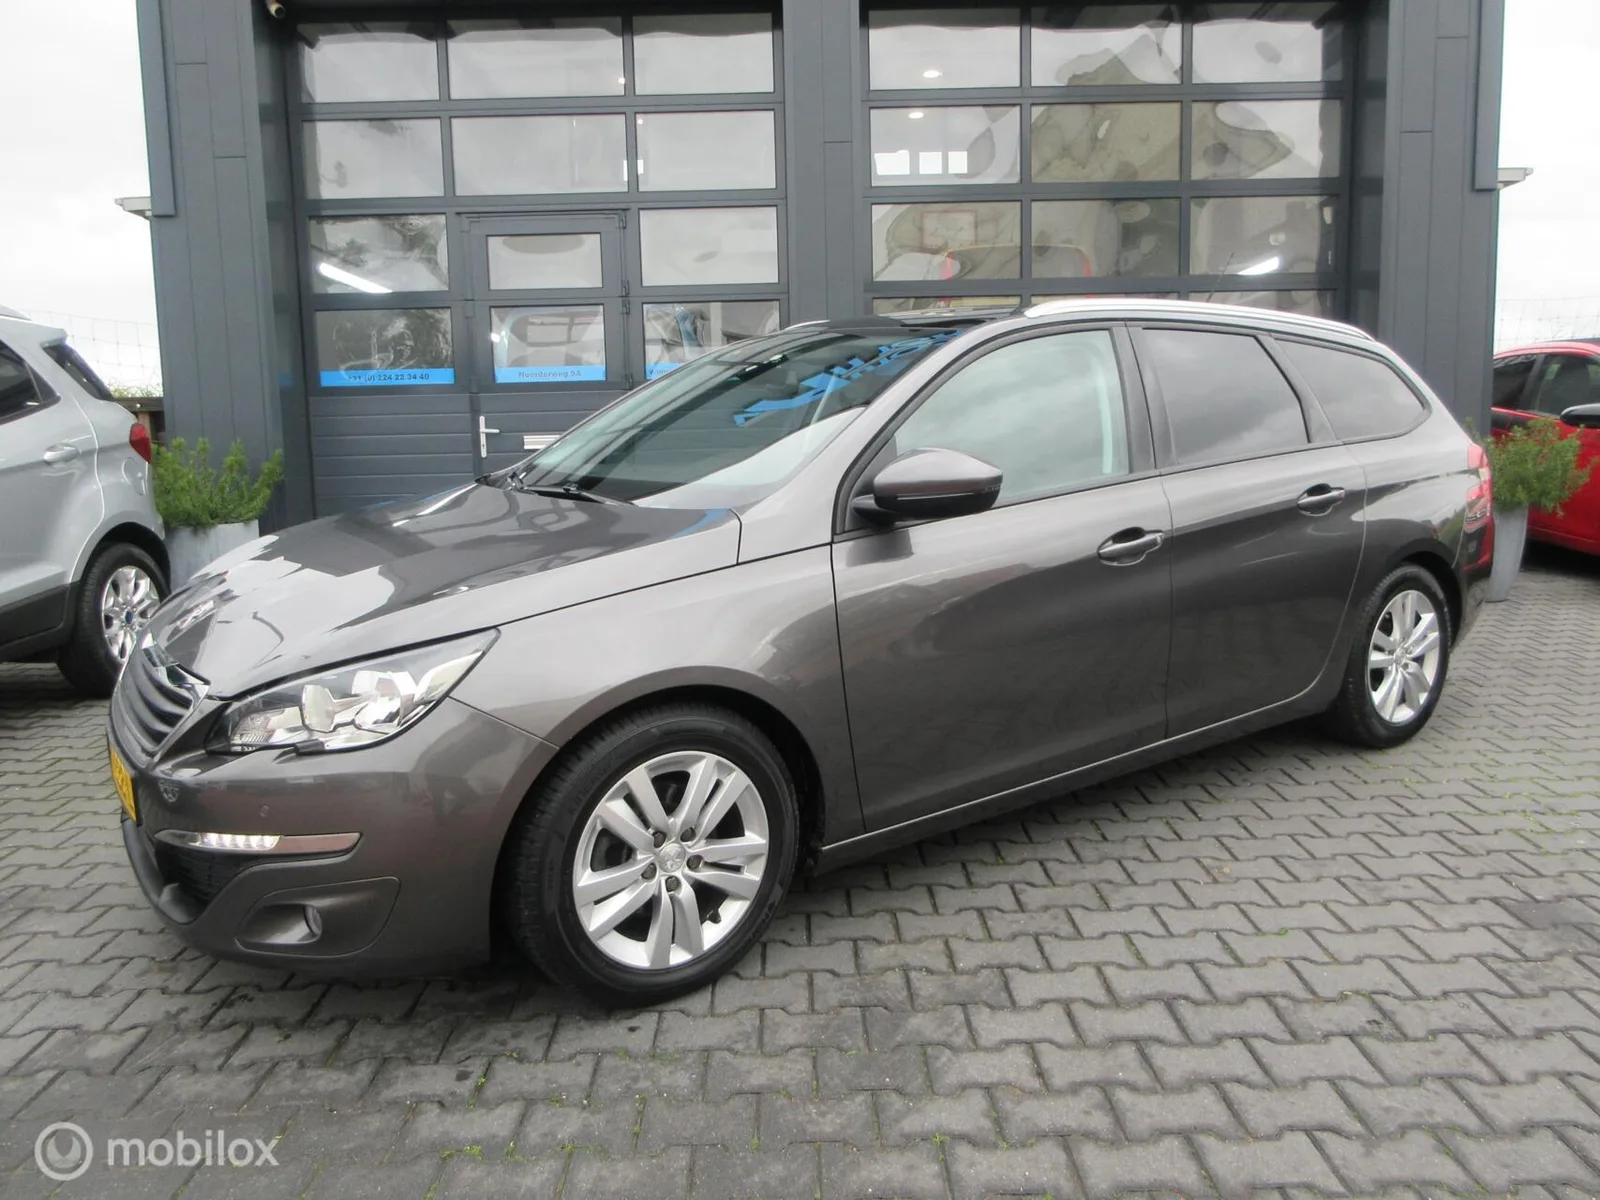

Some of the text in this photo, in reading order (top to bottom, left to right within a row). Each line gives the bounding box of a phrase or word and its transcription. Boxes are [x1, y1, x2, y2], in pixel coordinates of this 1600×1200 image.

[378, 373, 392, 381] 224
[407, 372, 417, 380] 34
[419, 372, 429, 380] 40
